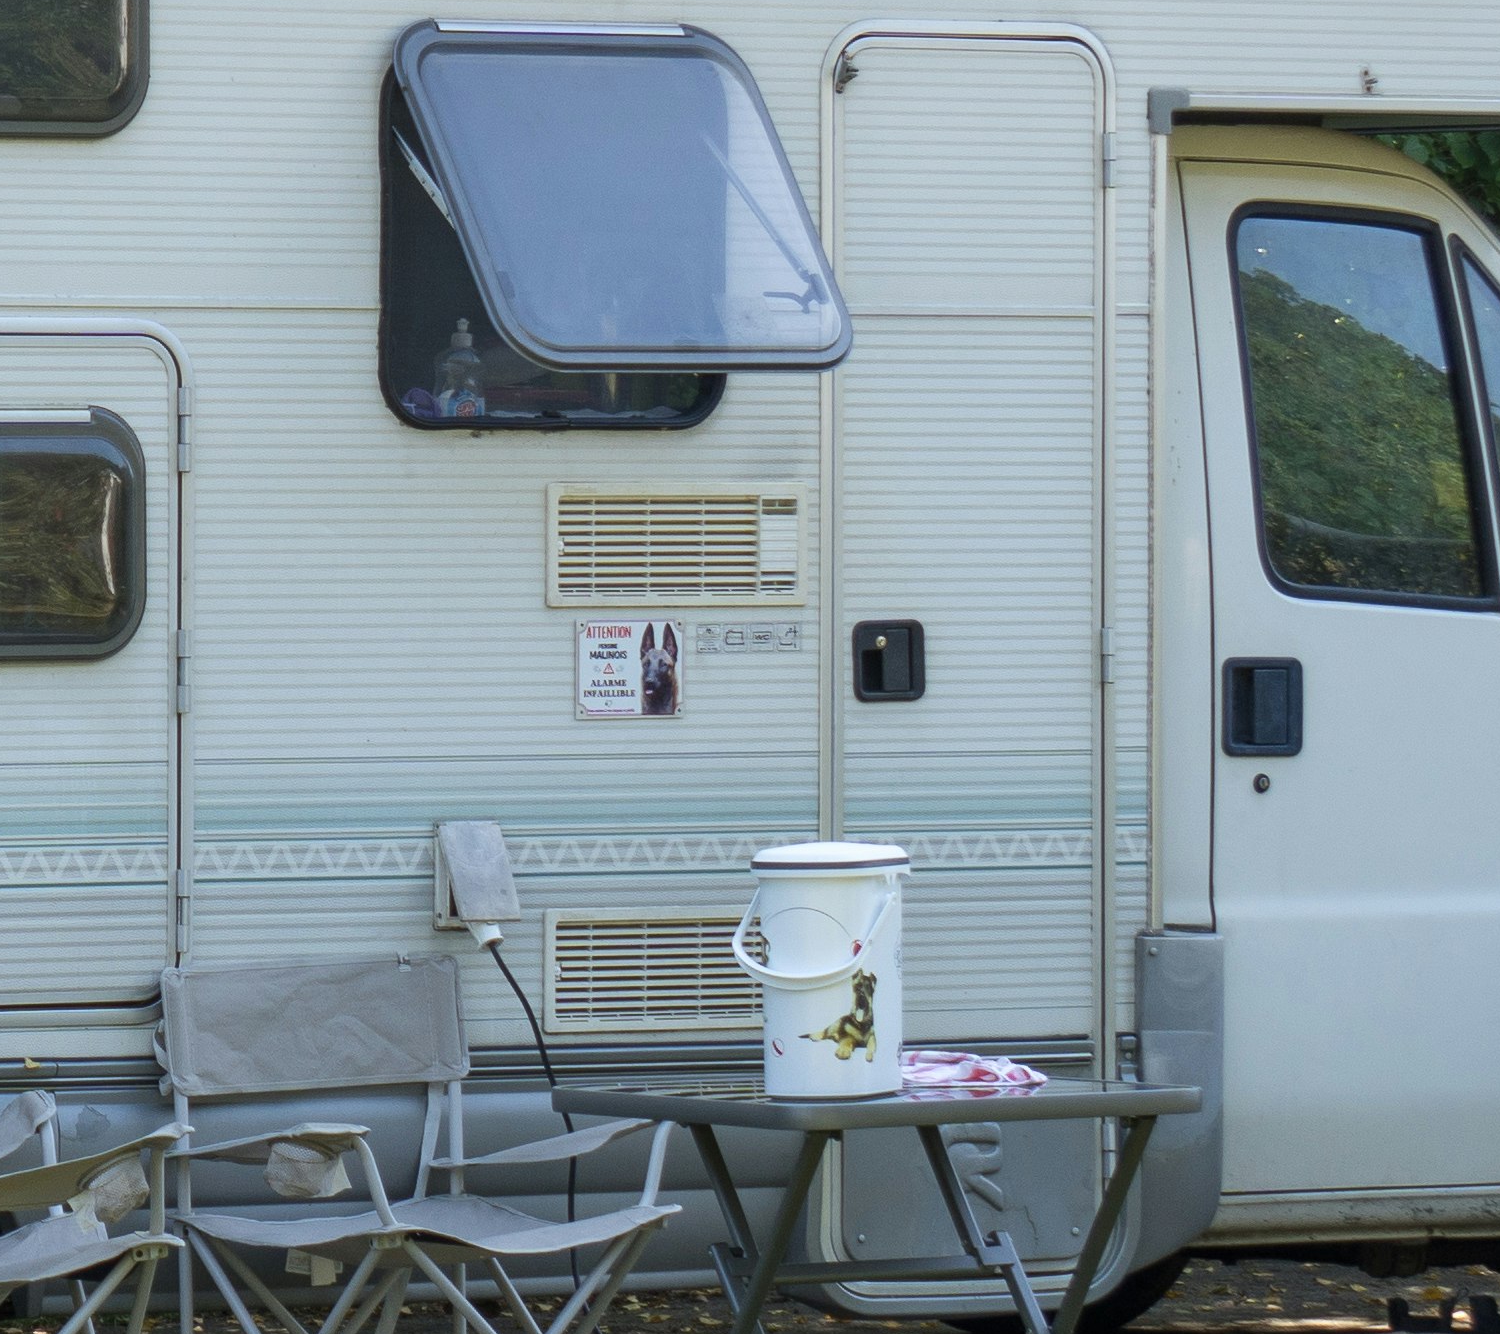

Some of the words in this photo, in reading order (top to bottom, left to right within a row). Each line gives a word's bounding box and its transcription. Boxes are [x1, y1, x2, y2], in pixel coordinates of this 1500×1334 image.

[586, 626, 632, 639] ATTENTION
[589, 650, 628, 660] MALINOIS
[590, 679, 627, 688] ALARME
[583, 689, 636, 698] INFAILLIBLE
